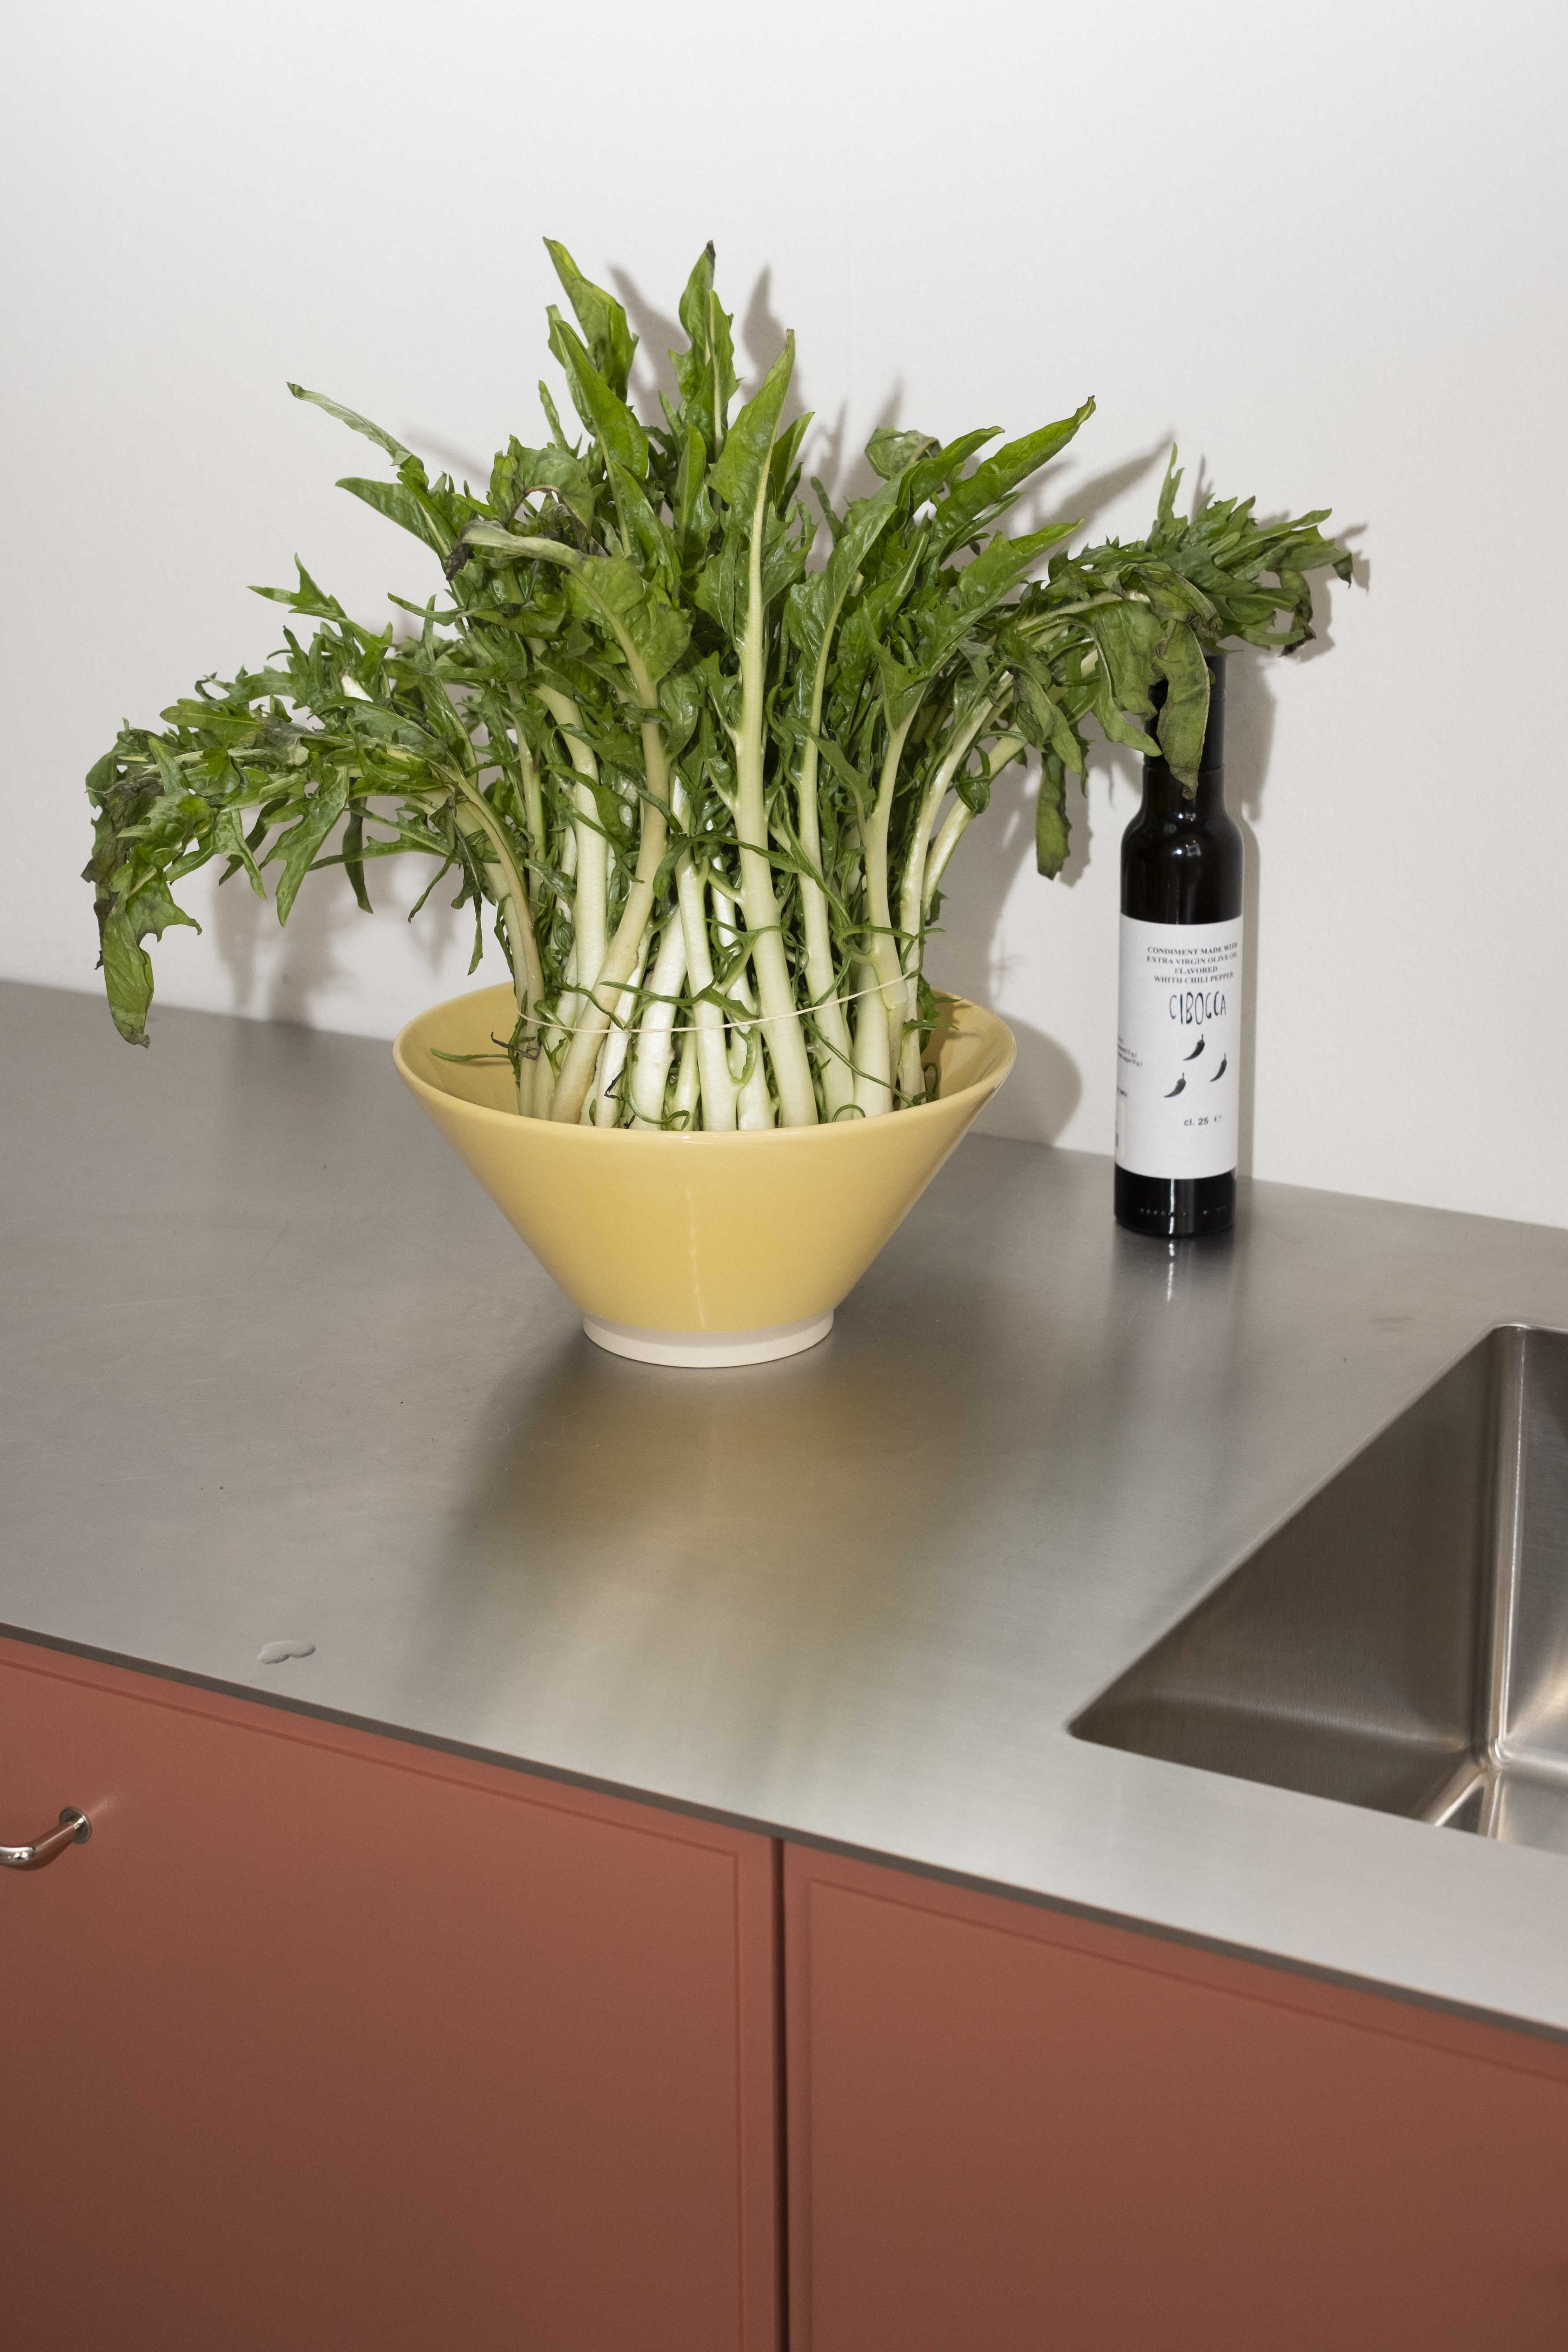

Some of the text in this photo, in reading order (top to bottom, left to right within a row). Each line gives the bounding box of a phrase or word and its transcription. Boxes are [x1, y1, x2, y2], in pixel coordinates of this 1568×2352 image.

[1147, 946, 1198, 955] CONDIMENT
[1201, 946, 1222, 955] MADE
[1147, 956, 1173, 965] EXTRA
[1208, 955, 1228, 963] OLIVE
[1210, 972, 1234, 982] PEPPER
[1198, 1117, 1208, 1126] 25
